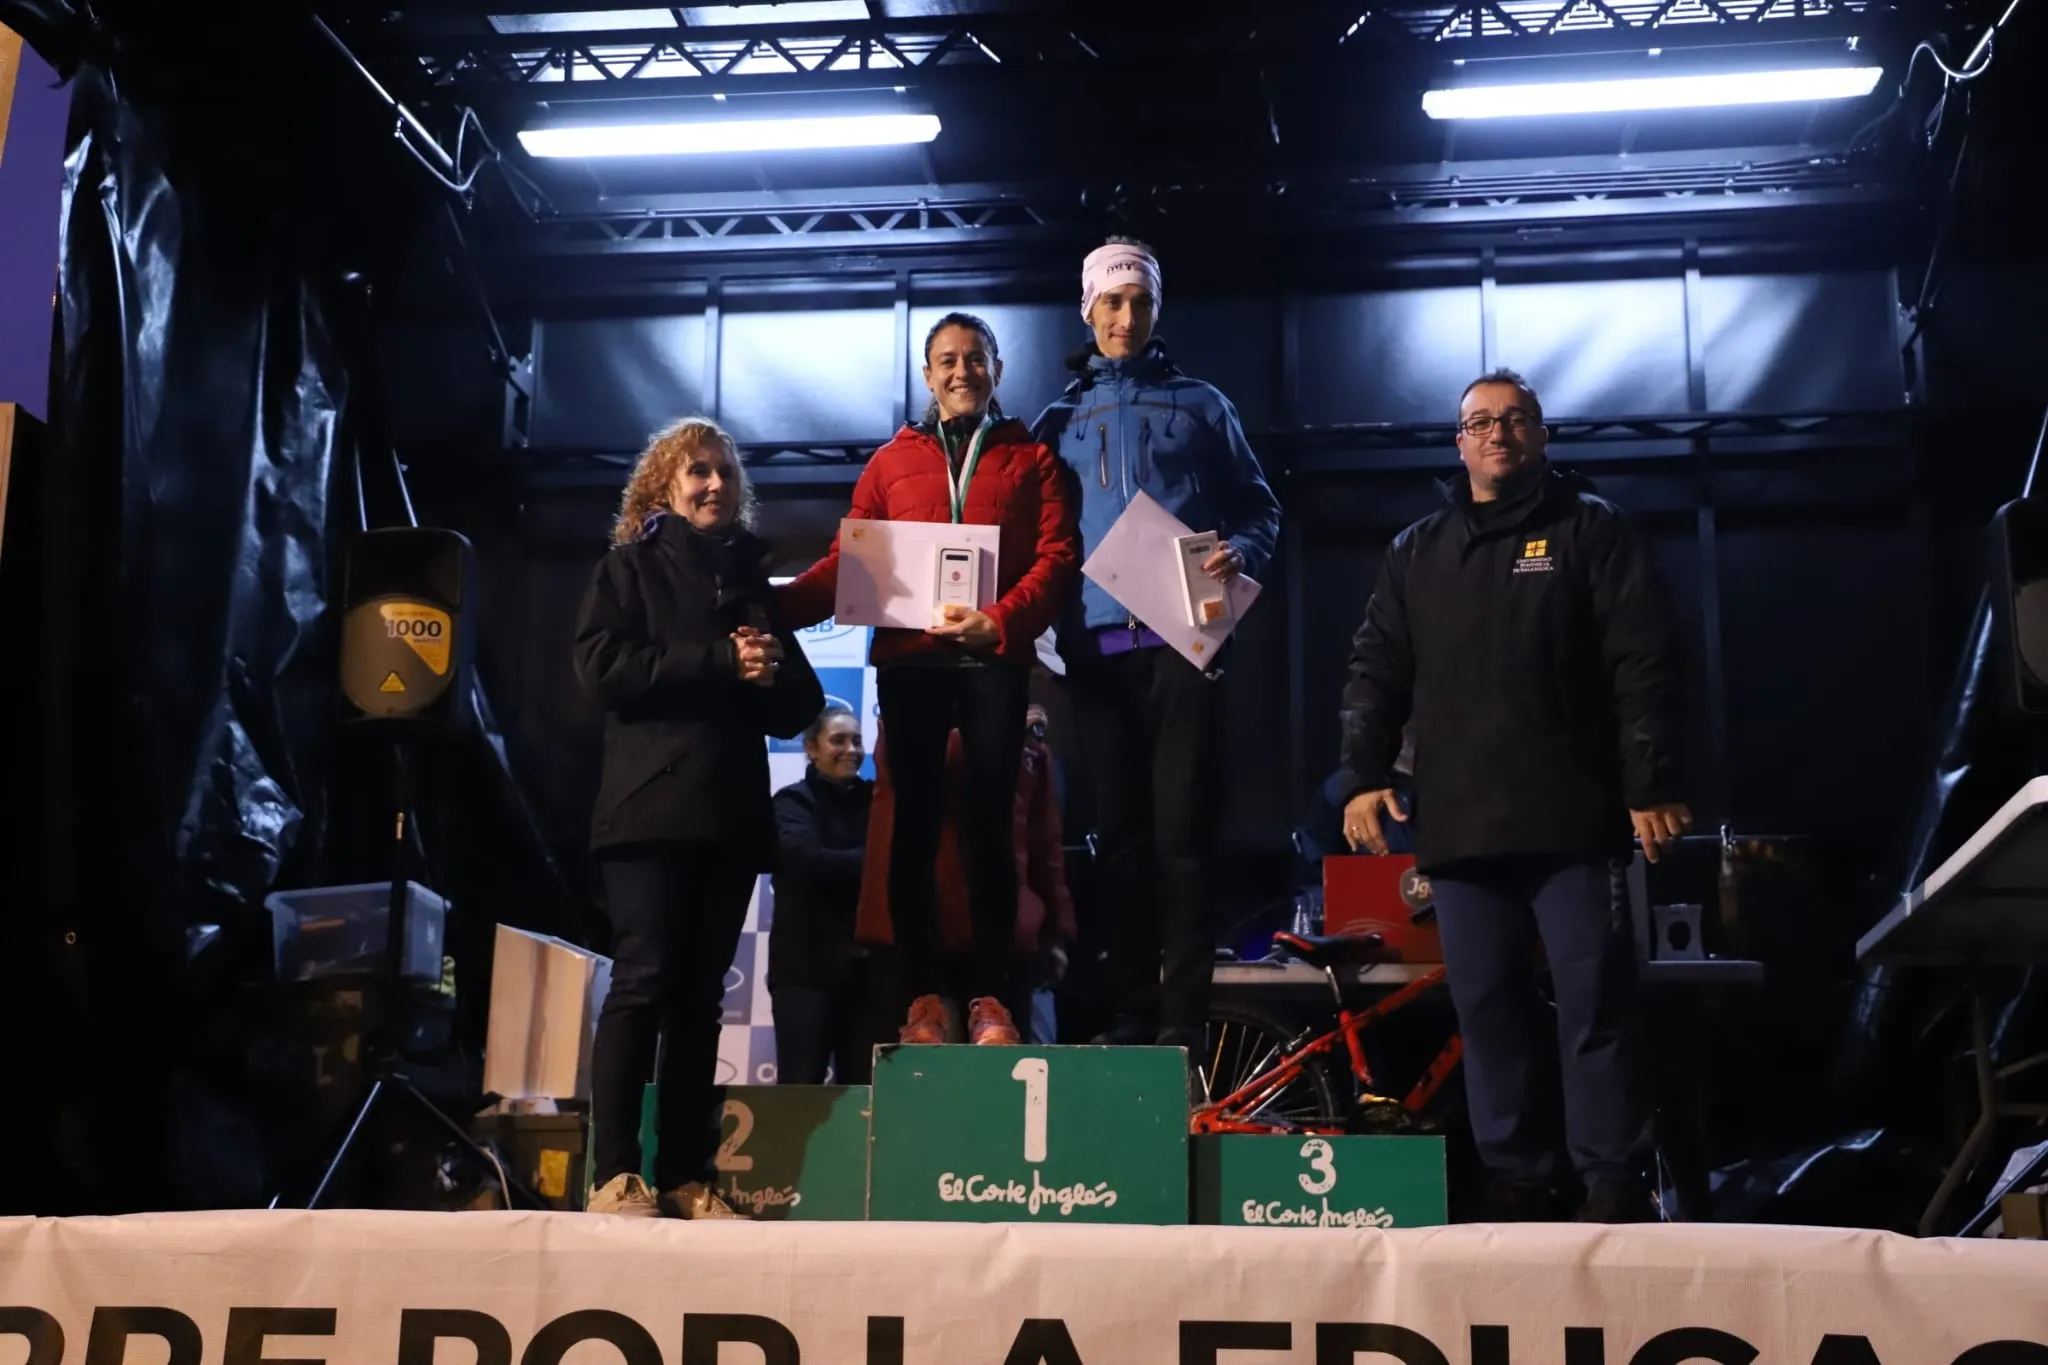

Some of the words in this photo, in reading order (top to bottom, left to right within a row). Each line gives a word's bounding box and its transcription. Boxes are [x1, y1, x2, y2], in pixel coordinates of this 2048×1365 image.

[385, 619, 442, 638] 1000
[715, 1099, 754, 1171] 2
[1011, 1057, 1049, 1163] 1
[938, 1172, 965, 1202] El
[966, 1174, 1027, 1204] Corte
[1028, 1169, 1118, 1216] Inglés
[1298, 1138, 1337, 1195] 3
[1242, 1200, 1265, 1224] El
[1266, 1201, 1317, 1225] Corte
